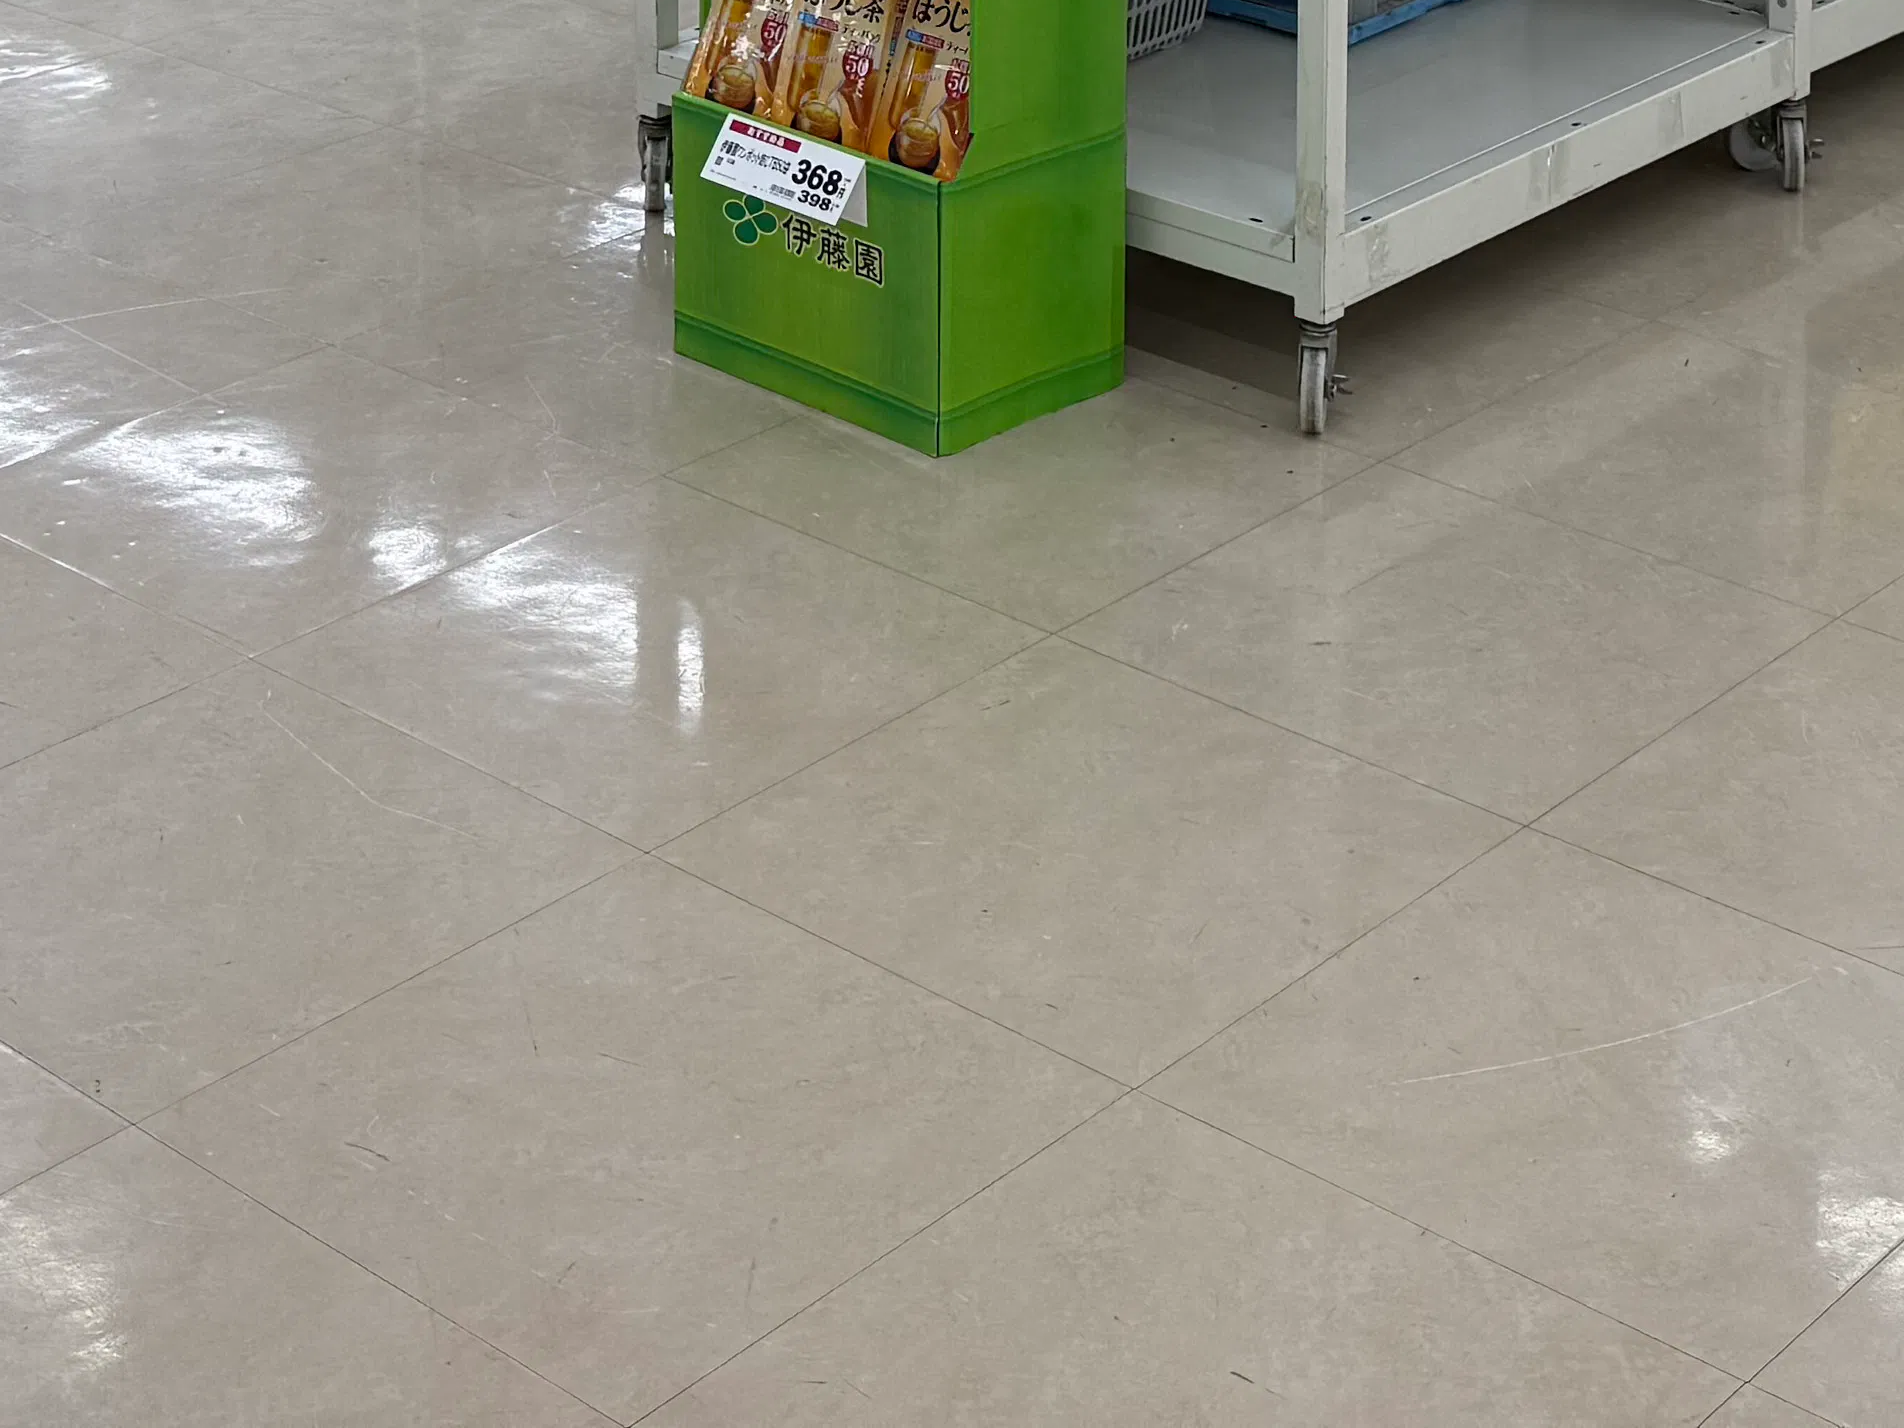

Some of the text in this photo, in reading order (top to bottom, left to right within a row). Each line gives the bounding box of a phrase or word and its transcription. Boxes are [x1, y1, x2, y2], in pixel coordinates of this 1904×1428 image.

[791, 159, 842, 196] 368
[798, 190, 832, 213] 398
[782, 215, 883, 286] 伊藤園
